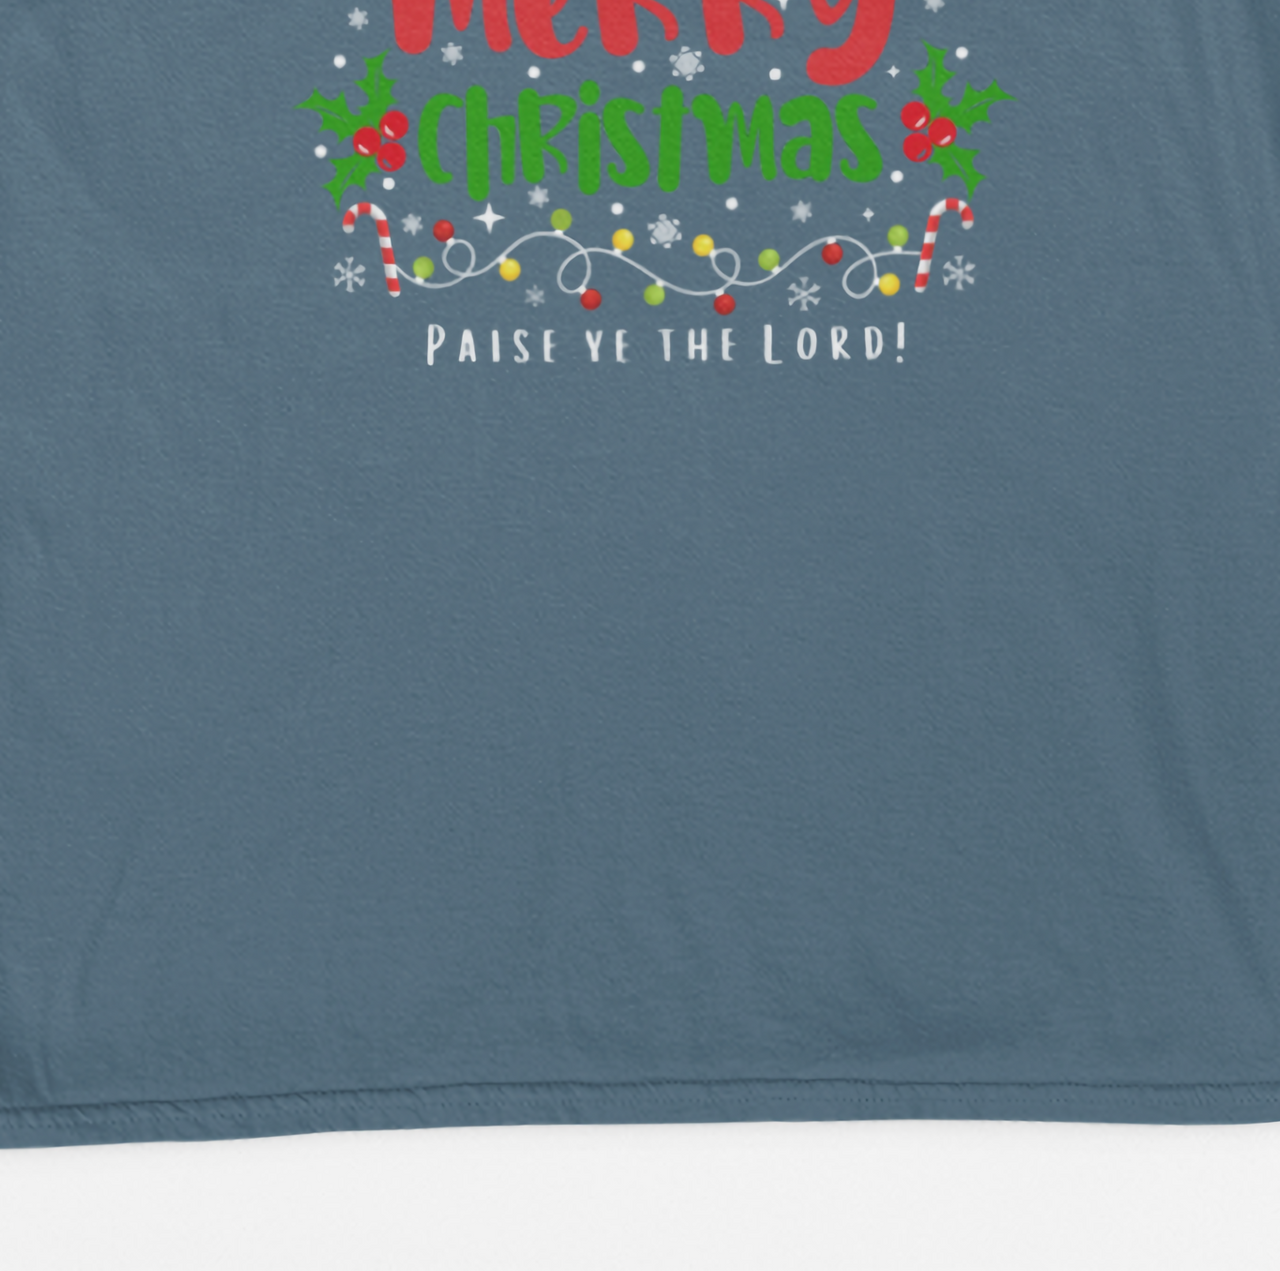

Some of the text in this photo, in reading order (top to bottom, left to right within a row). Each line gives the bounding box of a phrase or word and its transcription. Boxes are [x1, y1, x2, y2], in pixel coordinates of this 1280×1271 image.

[426, 321, 906, 366] PAISE YE THE LORD!
